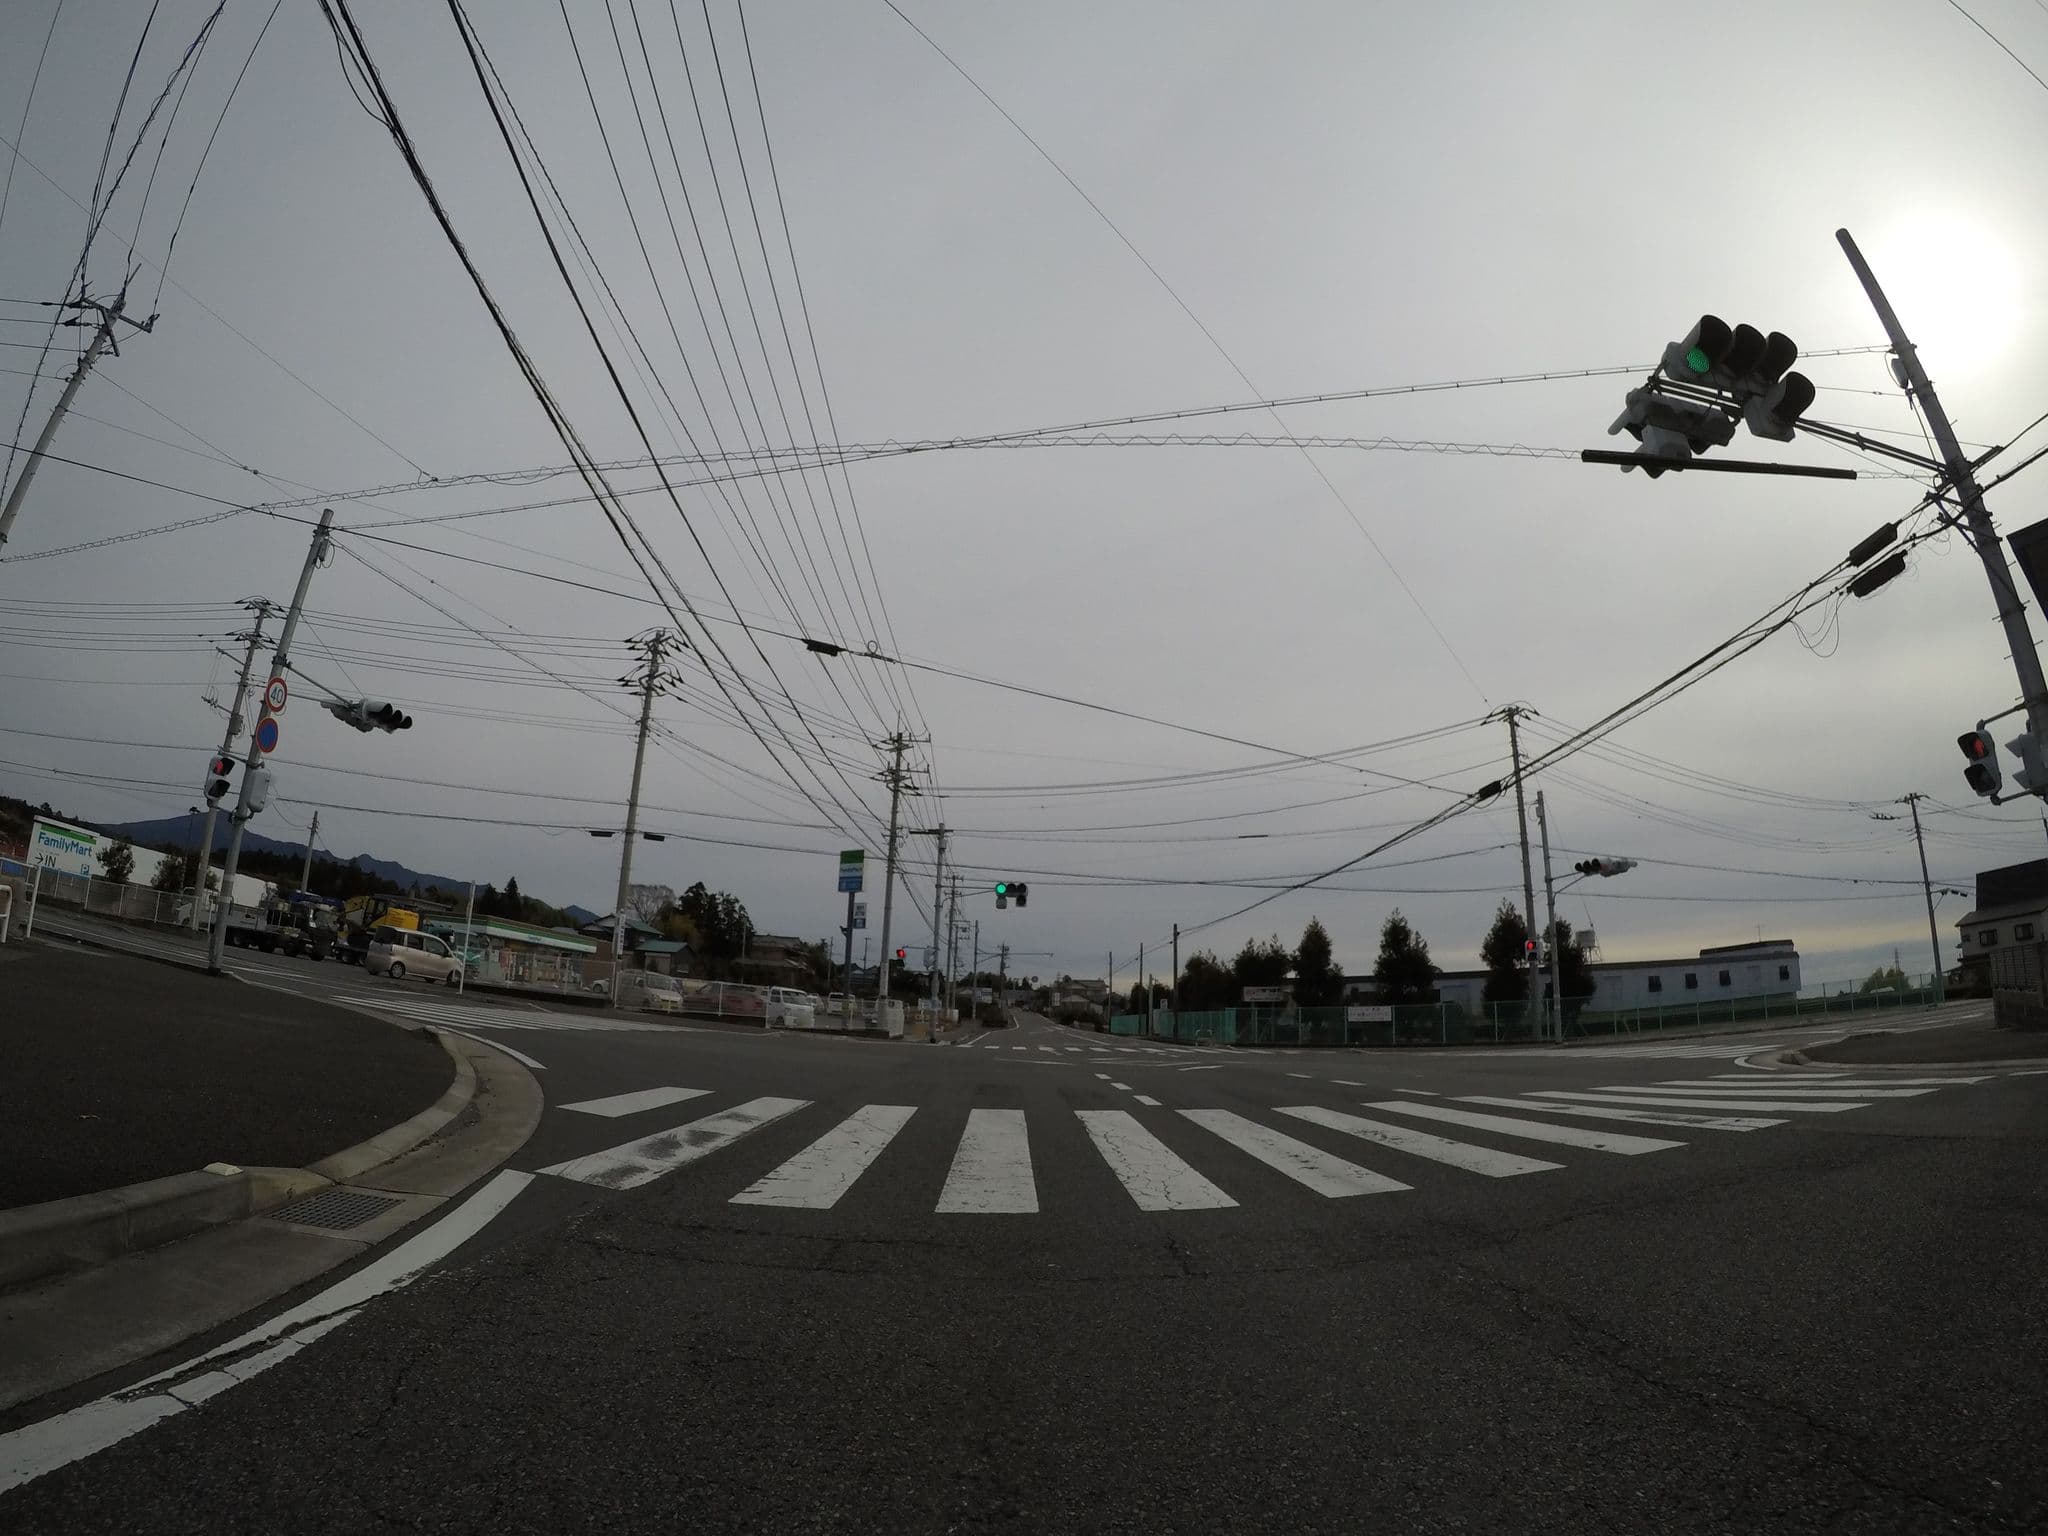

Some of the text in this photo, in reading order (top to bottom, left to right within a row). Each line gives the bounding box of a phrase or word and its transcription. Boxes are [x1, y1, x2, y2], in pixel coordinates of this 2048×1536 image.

[270, 687, 283, 703] 40
[37, 831, 93, 857] FamilyMart
[44, 854, 57, 868] IN
